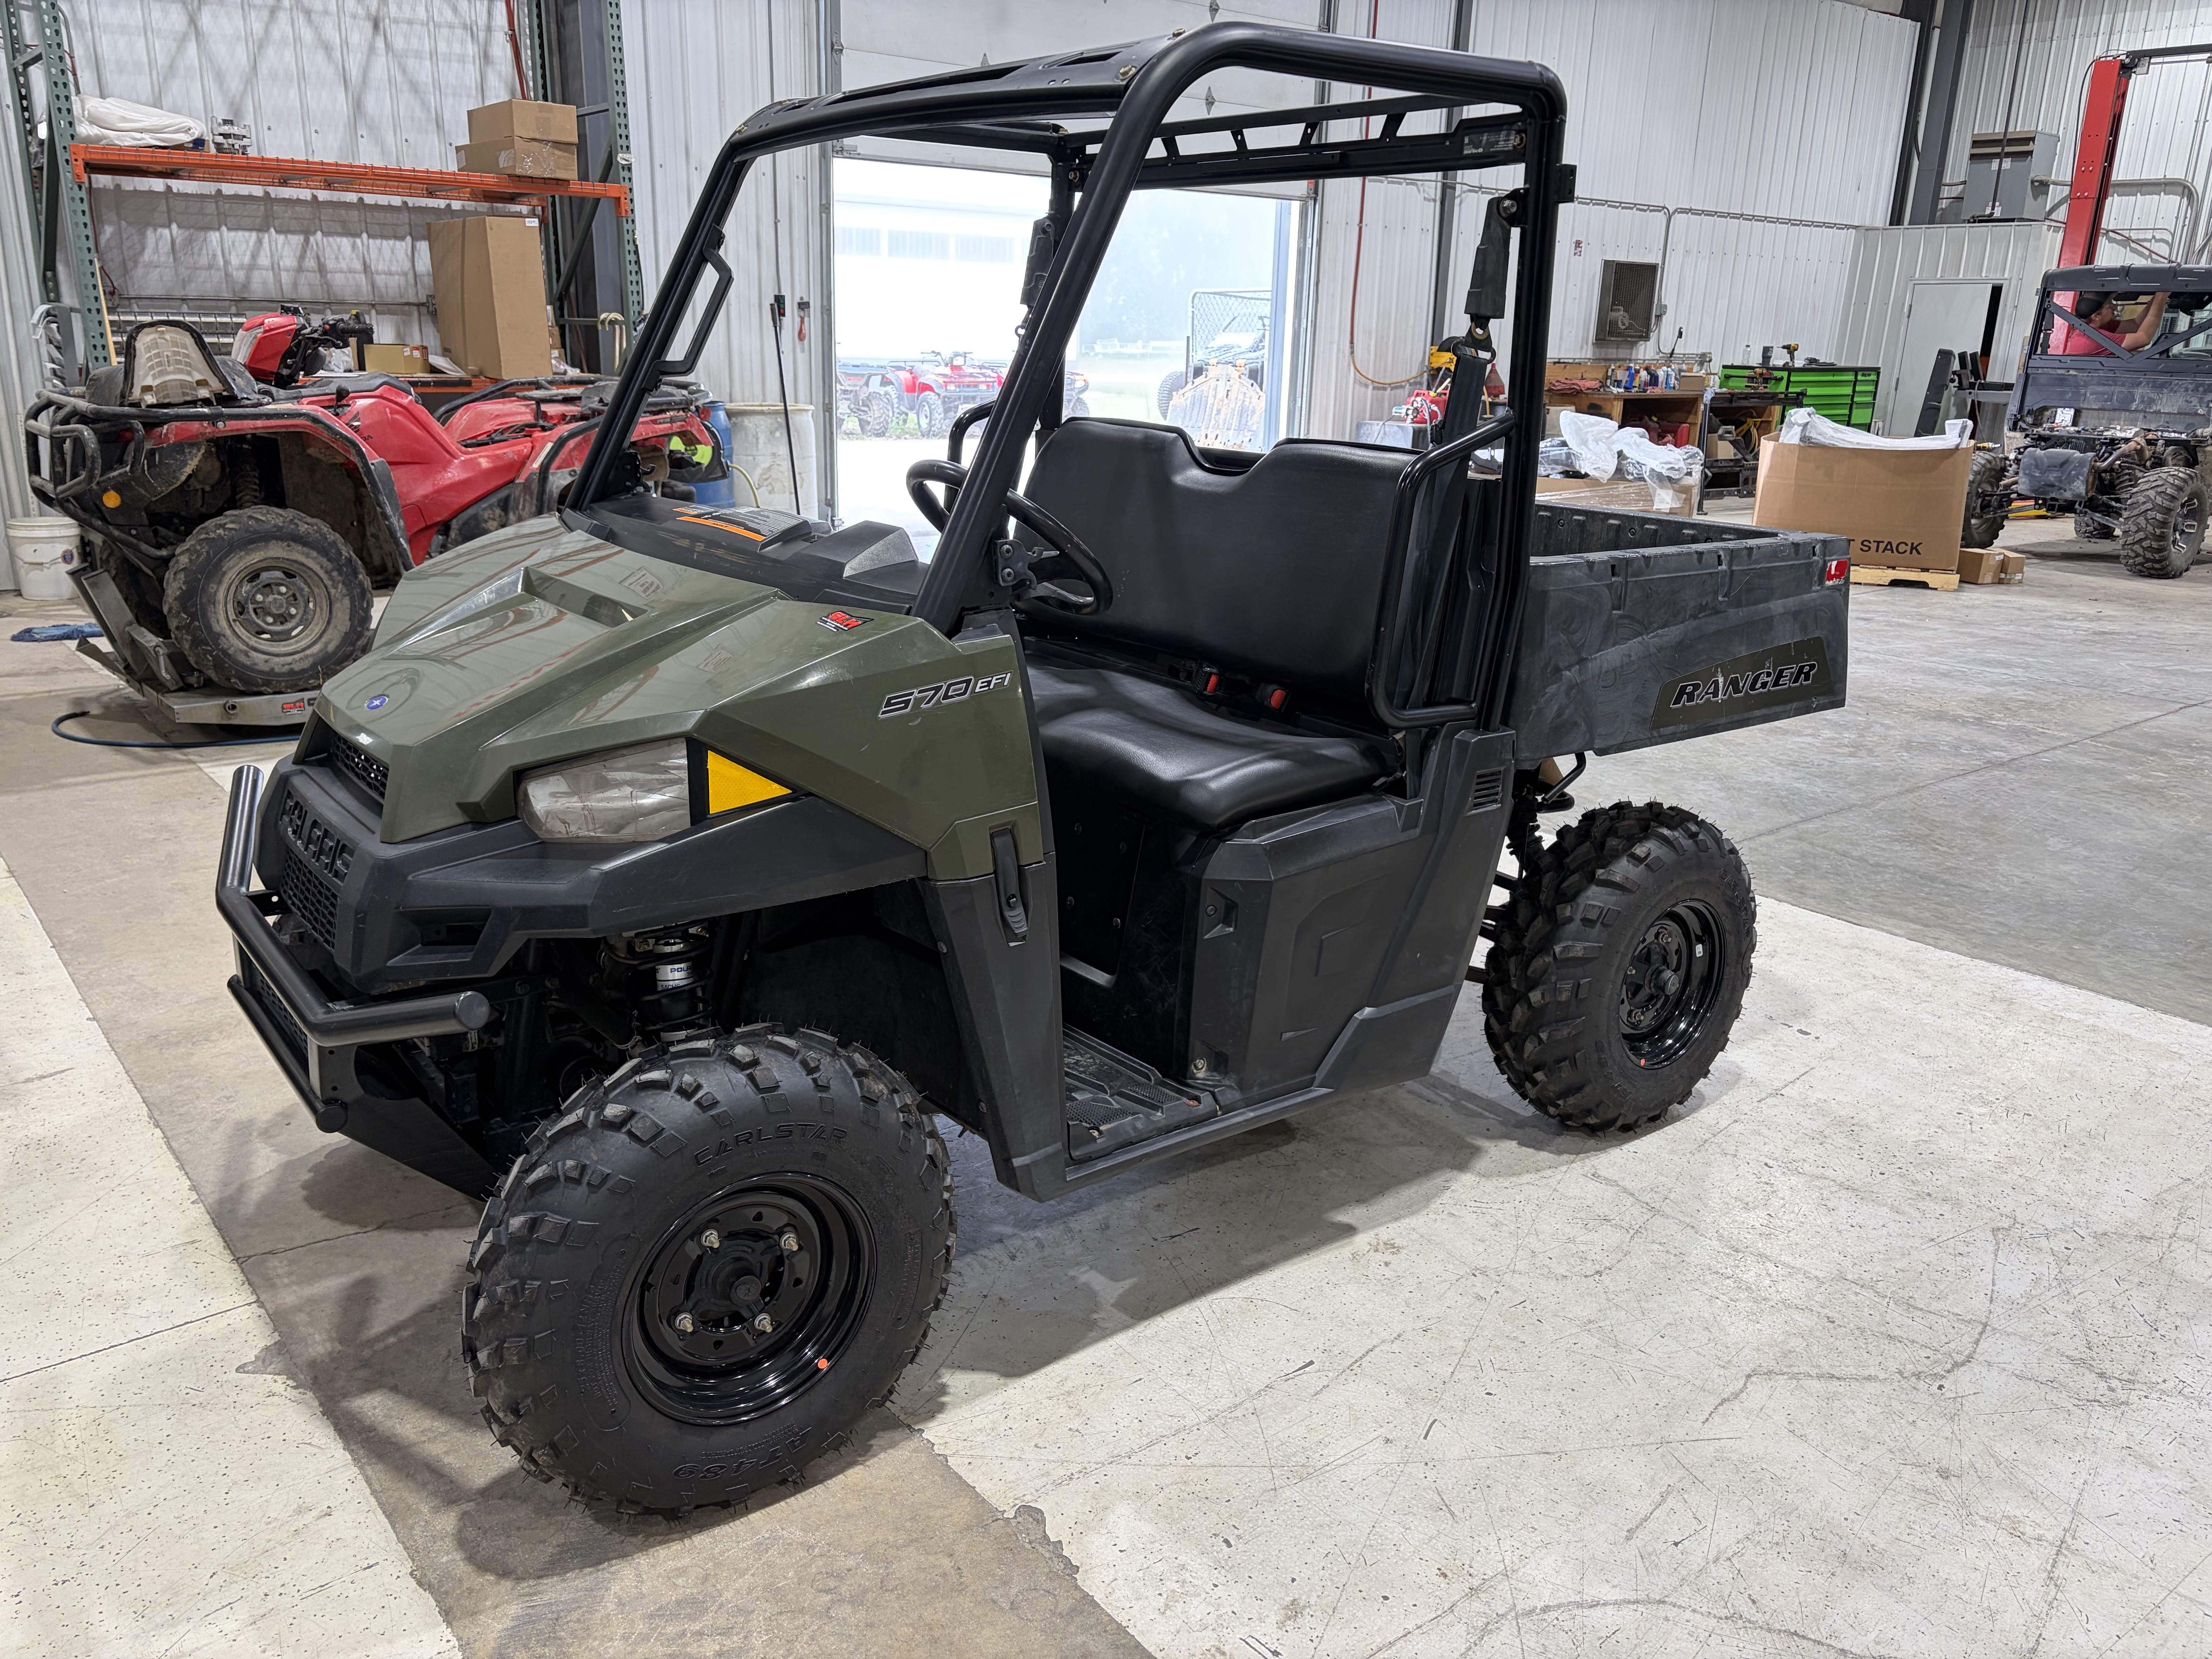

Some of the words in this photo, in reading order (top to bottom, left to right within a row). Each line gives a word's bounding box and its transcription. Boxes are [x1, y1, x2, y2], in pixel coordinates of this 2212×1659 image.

[1860, 539, 1923, 555] STACK
[828, 611, 862, 629] SLH
[878, 676, 974, 719] 570
[975, 673, 1012, 693] EFI
[1670, 661, 1818, 709] RANGER
[279, 788, 355, 886] POLARIS
[694, 1122, 848, 1167] CARLSTAR
[672, 1427, 812, 1480] AT489
